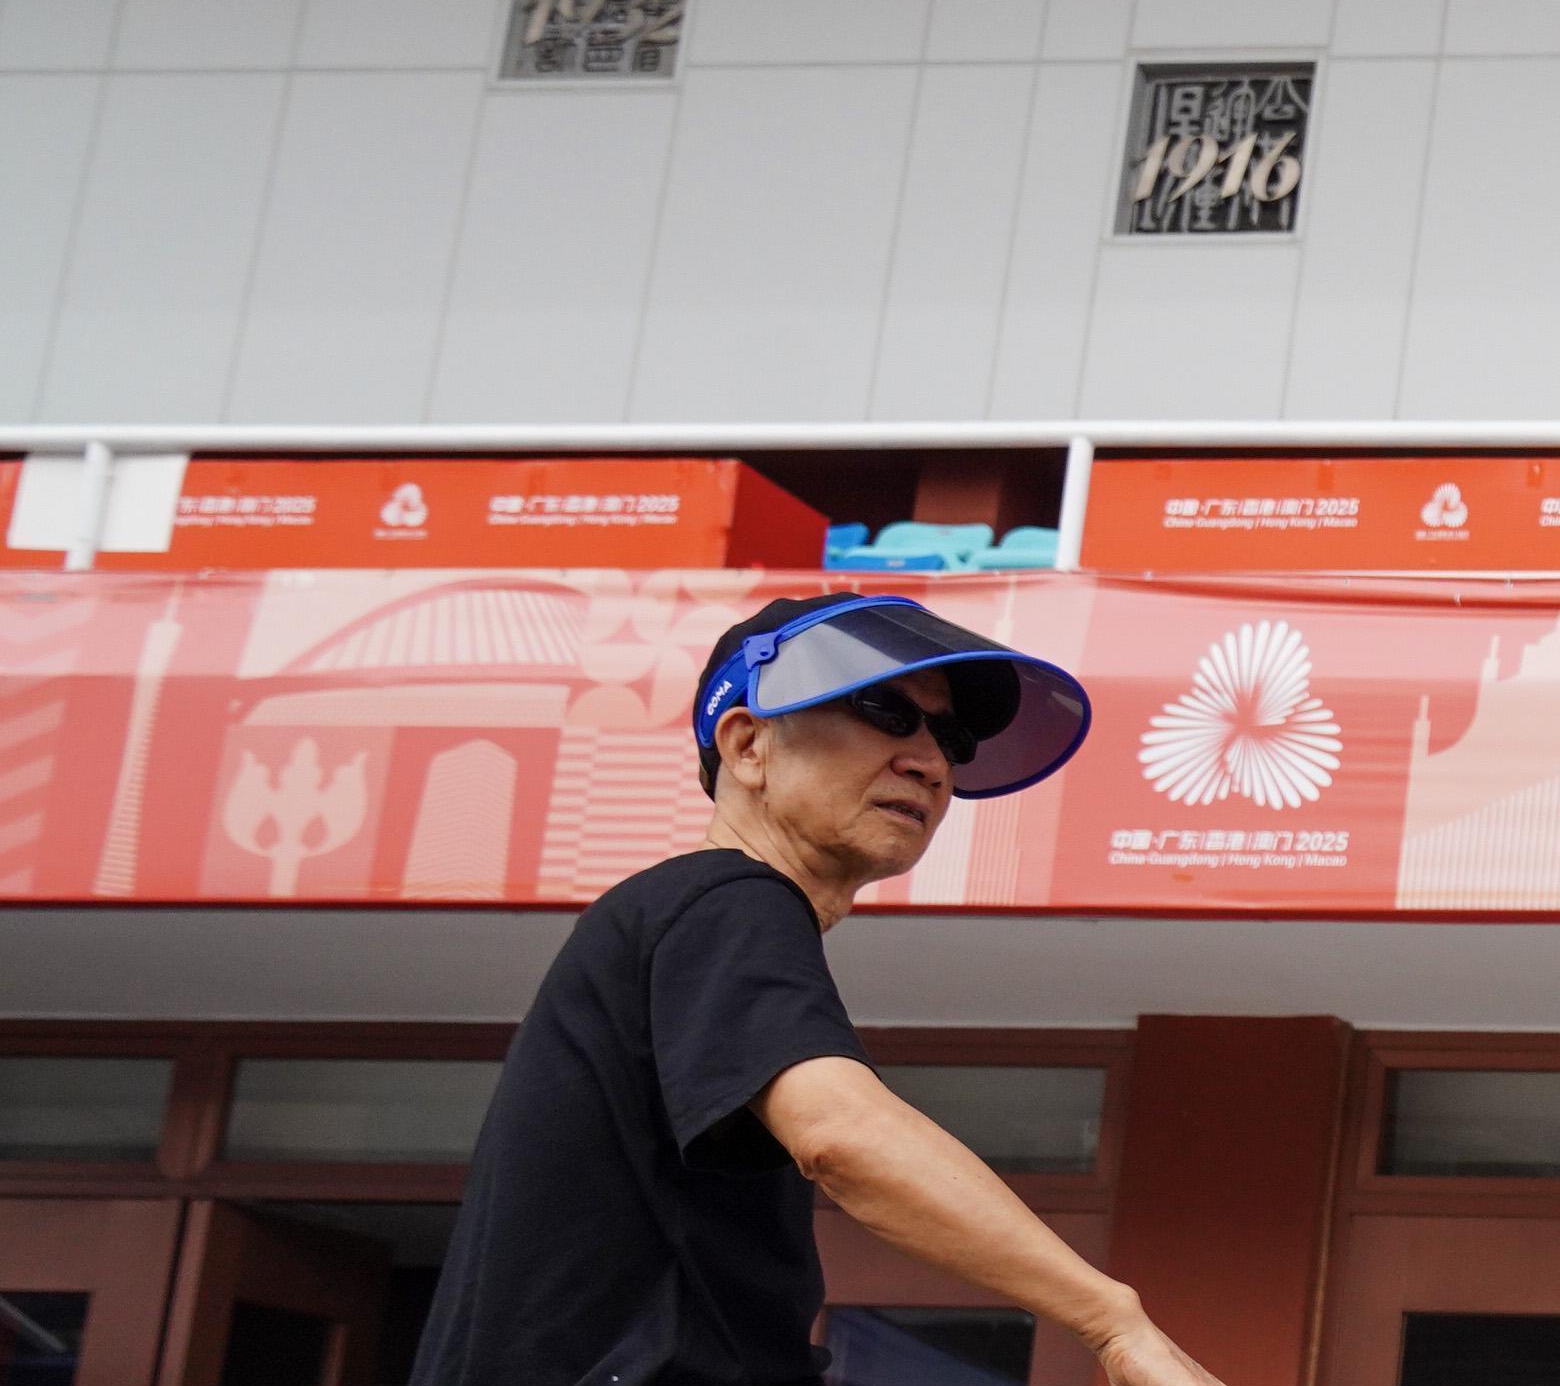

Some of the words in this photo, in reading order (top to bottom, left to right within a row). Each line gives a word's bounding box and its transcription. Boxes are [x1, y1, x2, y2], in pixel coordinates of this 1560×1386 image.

[1129, 131, 1300, 203] 1916
[1318, 498, 1359, 516] 2025
[706, 679, 733, 717] GOMA
[1298, 831, 1349, 851] 2025
[1229, 853, 1261, 868] Hong
[1265, 853, 1295, 868] Kong
[1307, 854, 1347, 866] Macao
